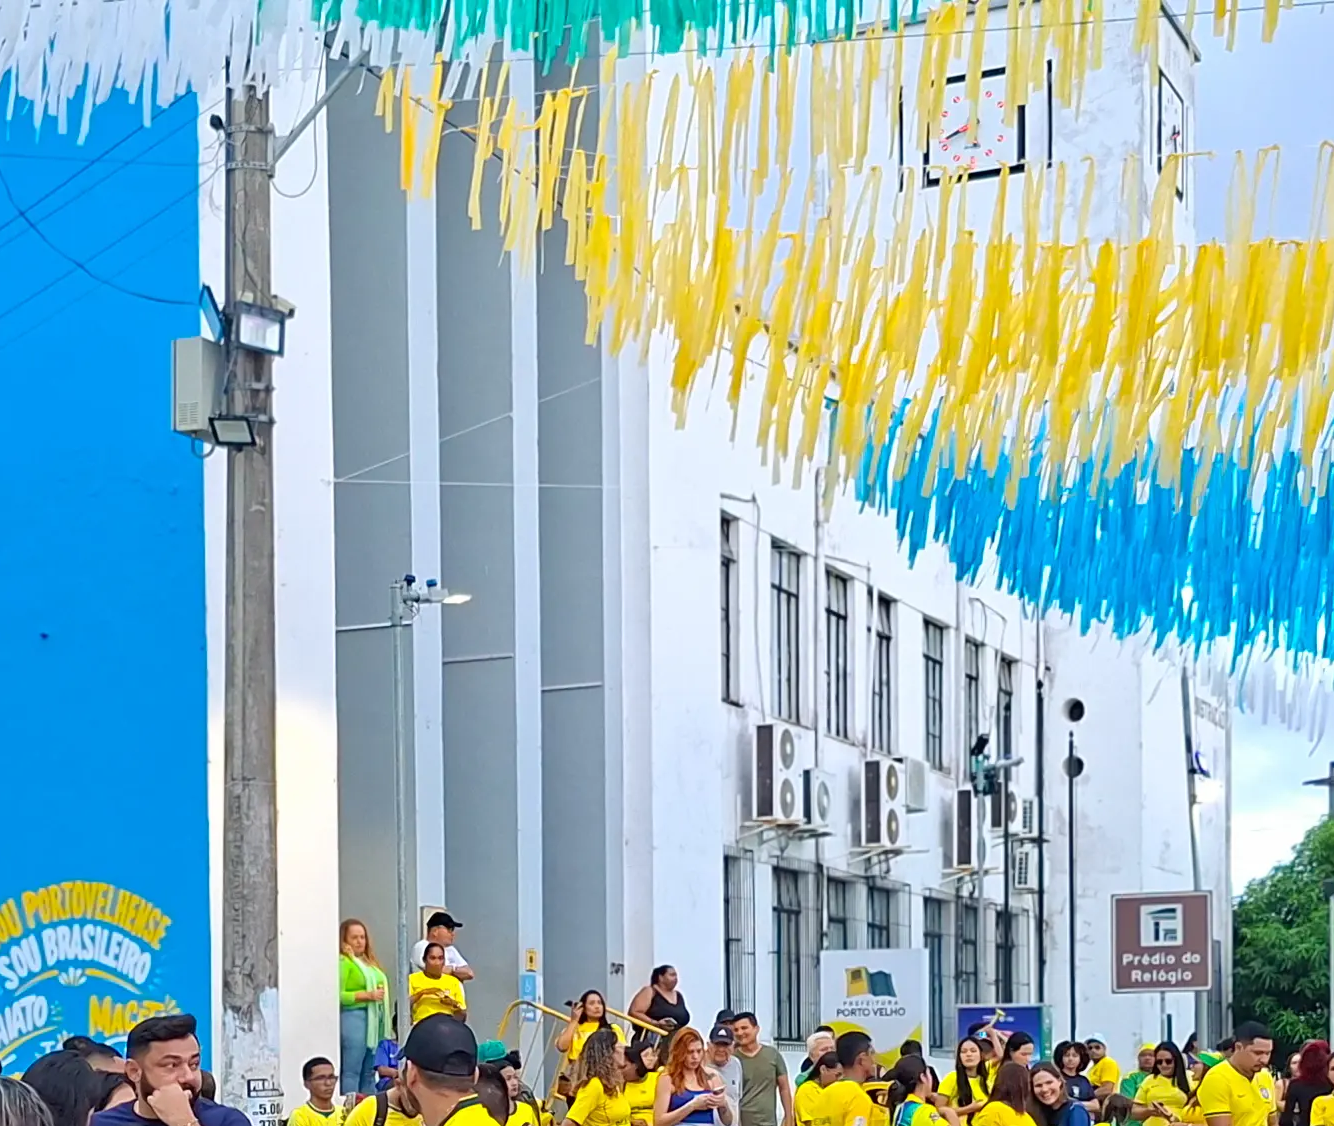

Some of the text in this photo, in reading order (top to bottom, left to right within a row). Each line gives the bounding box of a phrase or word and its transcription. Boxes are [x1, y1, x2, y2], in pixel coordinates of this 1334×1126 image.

[21, 880, 172, 950] PORTOVELHENSE
[42, 923, 152, 985] BRASILEIRO
[1122, 951, 1201, 966] Prédio do
[1131, 969, 1193, 985] Relógio
[88, 995, 166, 1037] MACET
[836, 1007, 906, 1017] PORTO VELHO
